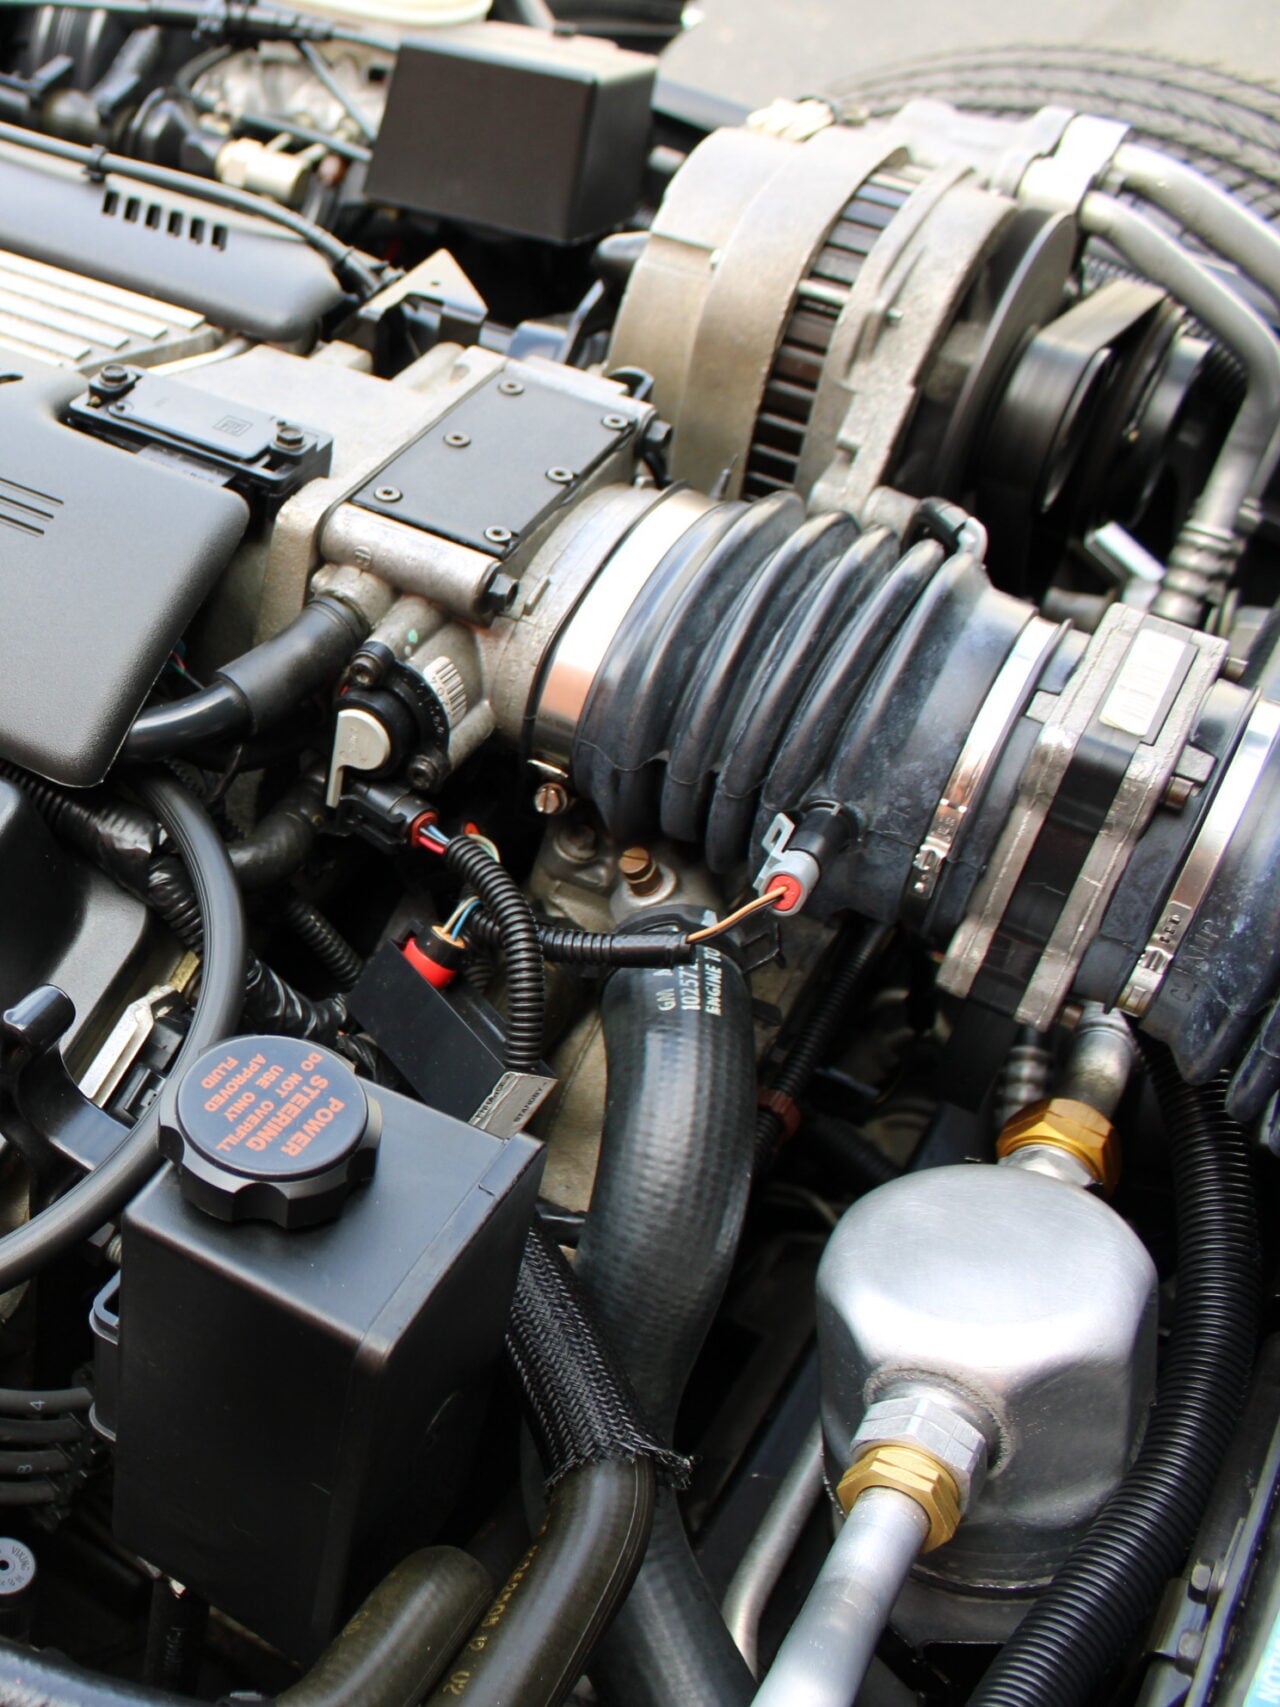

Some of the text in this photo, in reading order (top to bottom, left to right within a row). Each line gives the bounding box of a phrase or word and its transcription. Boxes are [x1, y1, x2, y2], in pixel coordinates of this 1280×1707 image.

[655, 988, 677, 1012] GM
[703, 946, 723, 1017] ENGINE TO
[200, 1055, 240, 1089] FLUID
[203, 1053, 267, 1113] APPROVED
[215, 1052, 324, 1152] DO NOT OVERFILL
[223, 1064, 285, 1122] USE ONLY
[245, 1074, 330, 1152] STEERING
[280, 1097, 346, 1157] POWER
